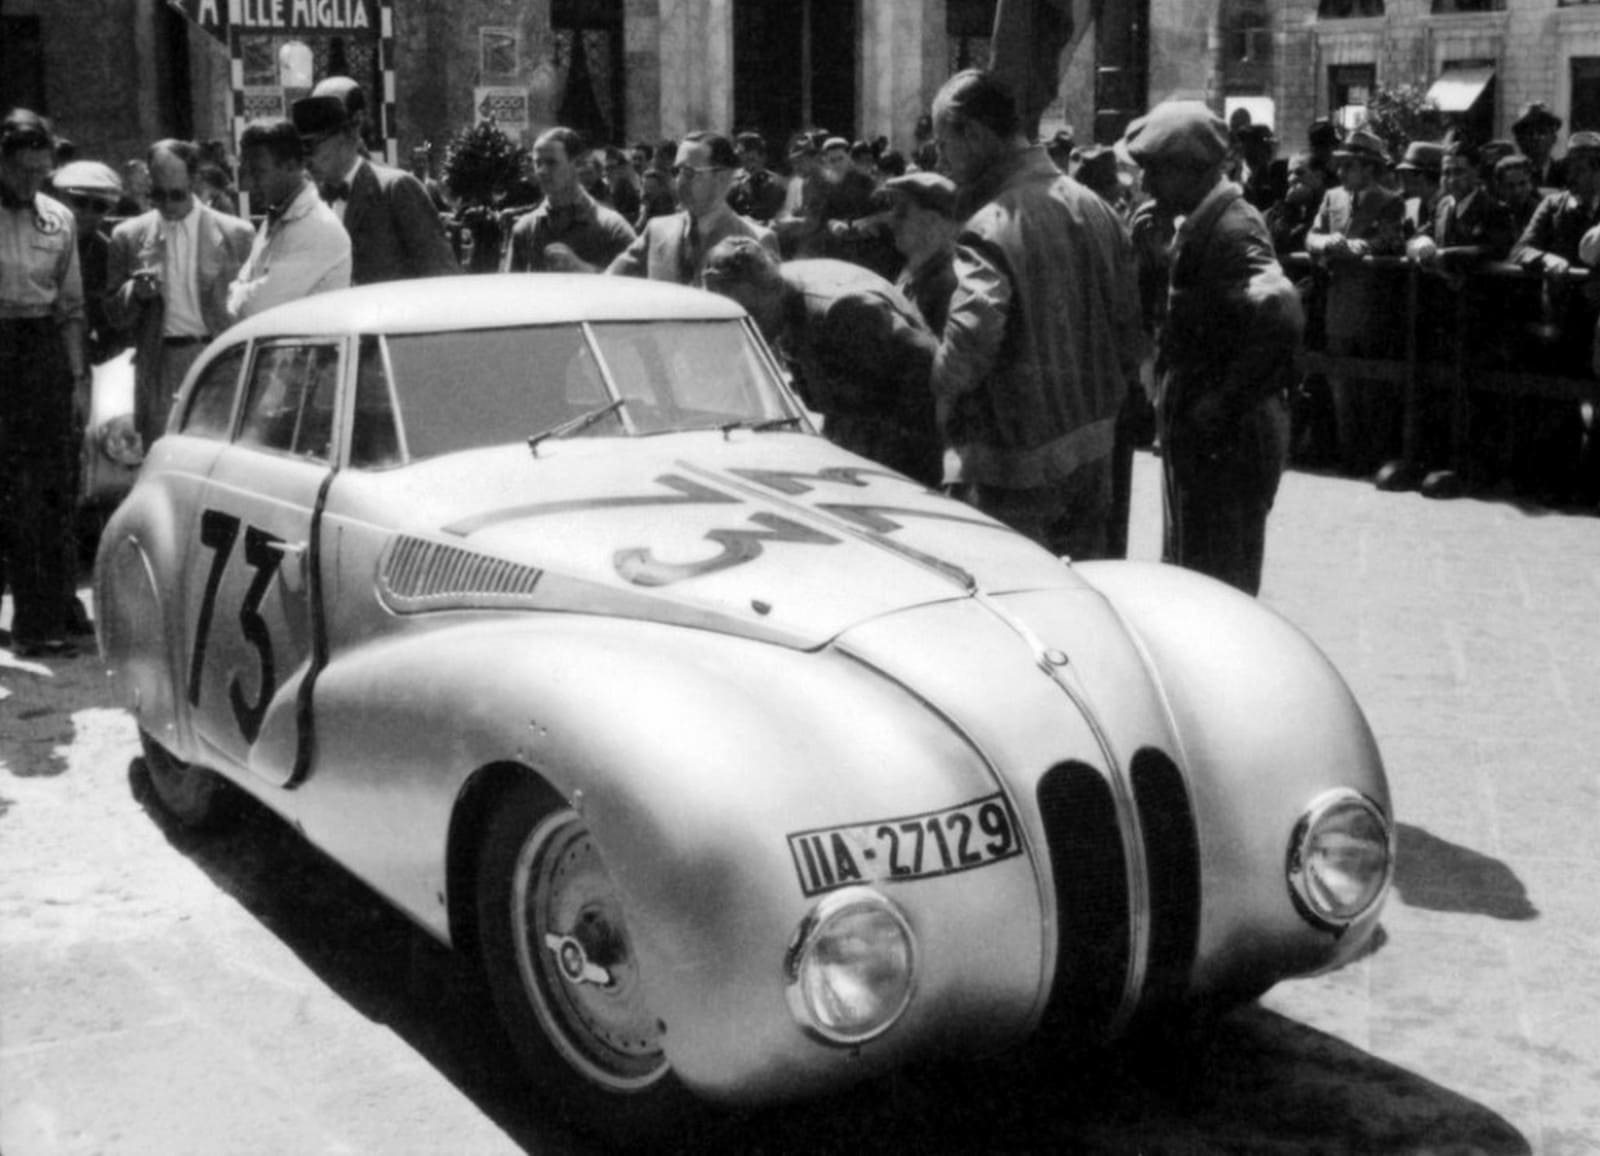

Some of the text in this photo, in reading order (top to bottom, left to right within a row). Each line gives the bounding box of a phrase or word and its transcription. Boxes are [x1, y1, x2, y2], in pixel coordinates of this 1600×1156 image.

[197, 0, 369, 28] MLLE MIGLIA
[189, 508, 286, 746] 73
[799, 803, 1012, 888] IIA-27129
